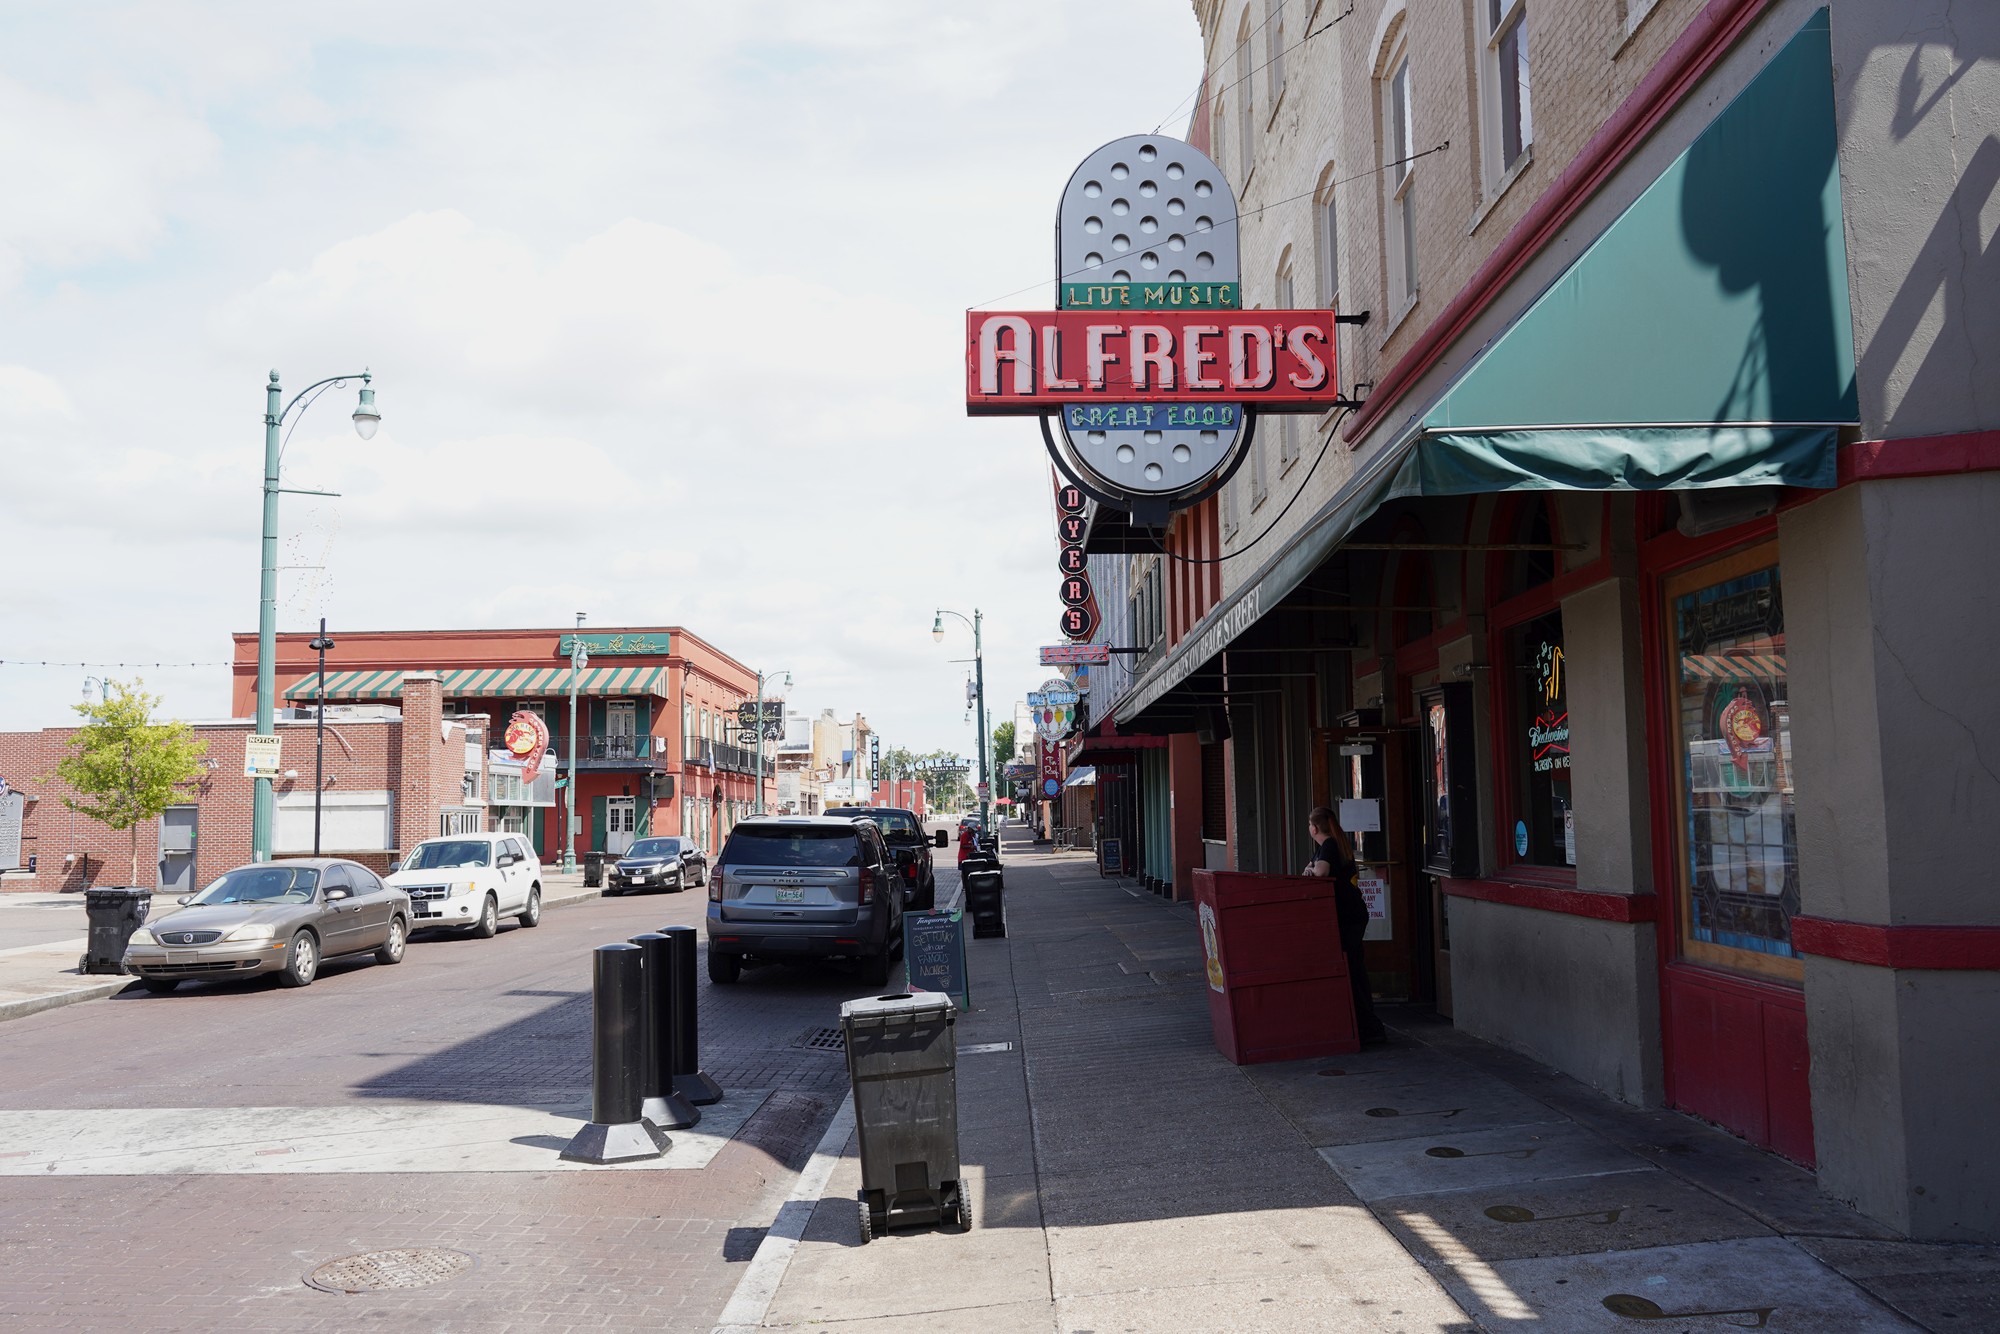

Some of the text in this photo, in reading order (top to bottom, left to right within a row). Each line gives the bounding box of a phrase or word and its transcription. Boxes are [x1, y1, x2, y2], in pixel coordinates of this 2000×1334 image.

[1069, 285, 1232, 306] LIVE MUSIC
[979, 315, 1326, 395] ALFRED'S
[1071, 405, 1234, 427] GREAT FOOD
[1066, 489, 1082, 630] DYER'S
[1200, 619, 1223, 661] BEALE
[1223, 582, 1262, 641] STREET
[608, 635, 624, 652] Lee
[628, 635, 658, 652] Lewis
[905, 756, 943, 772] HOME
[1555, 757, 1562, 769] ON
[1364, 887, 1375, 895] WILL
[1371, 880, 1377, 888] OR
[916, 917, 950, 925] Tanqueray
[918, 953, 950, 965] FAMOUS
